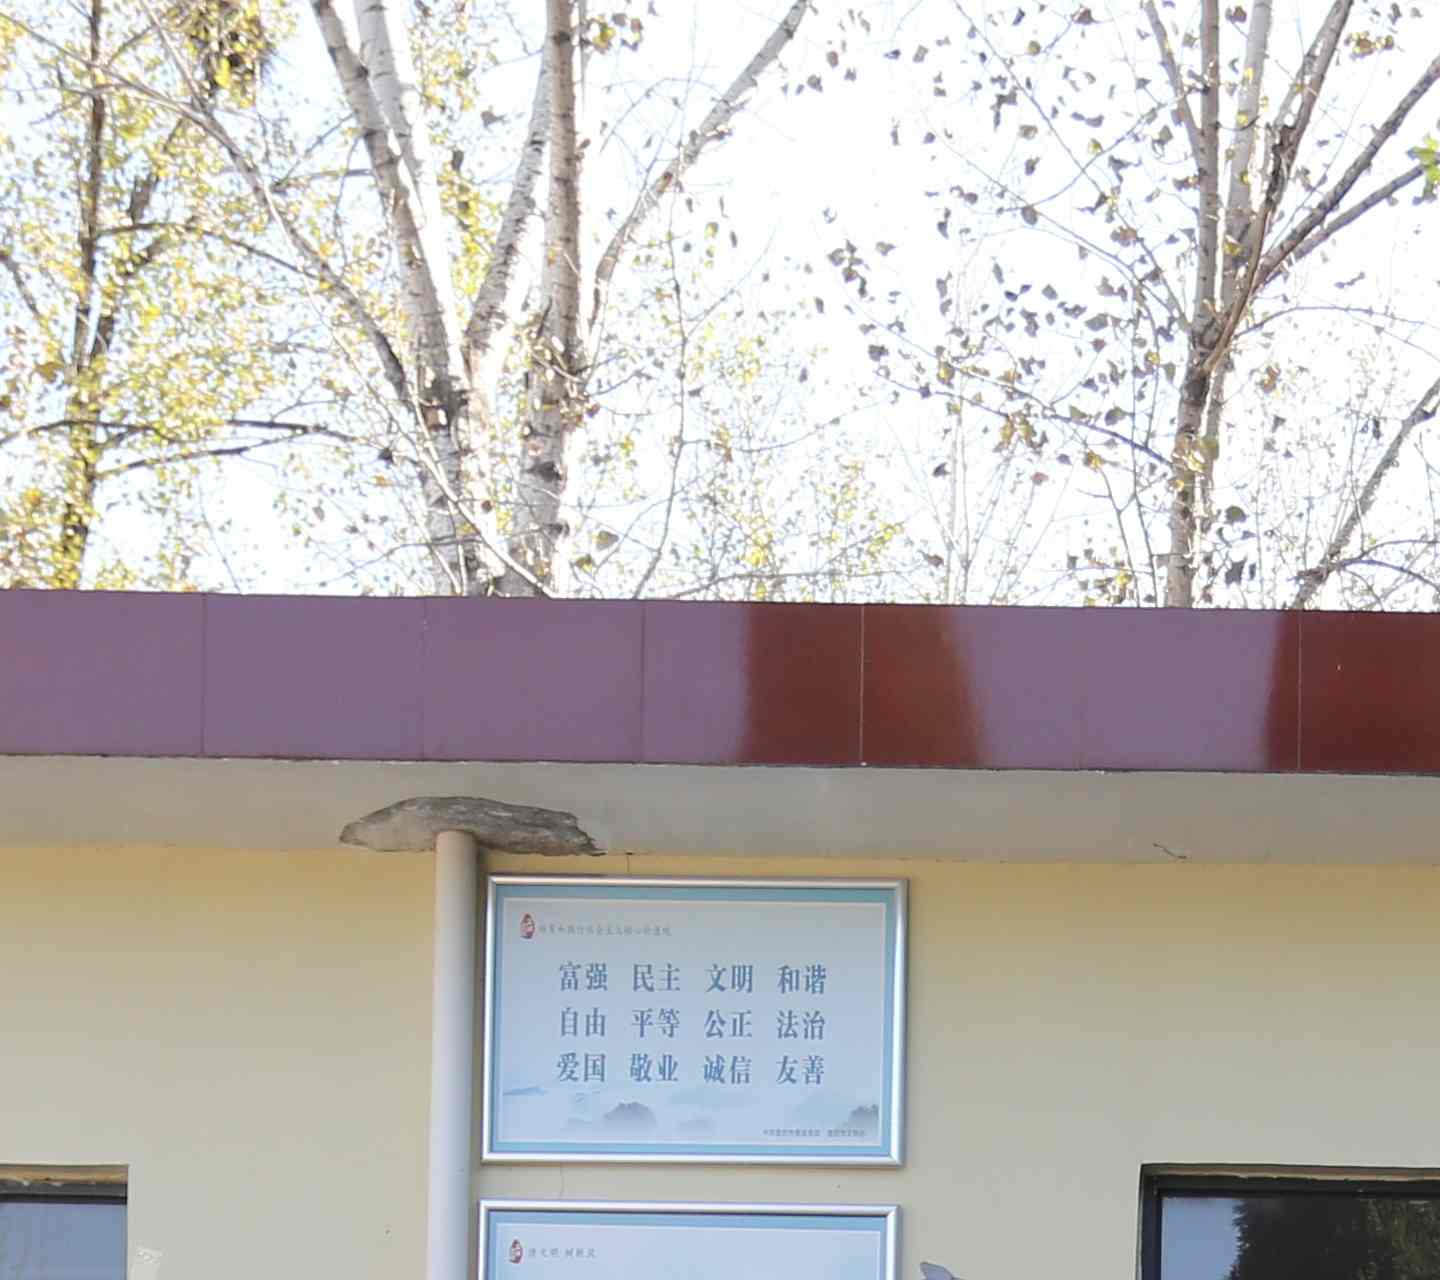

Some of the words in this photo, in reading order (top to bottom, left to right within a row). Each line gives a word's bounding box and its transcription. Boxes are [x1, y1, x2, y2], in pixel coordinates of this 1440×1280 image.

[560, 962, 608, 993] 富强
[632, 964, 680, 993] 民主
[705, 964, 753, 994] 文明
[777, 964, 826, 994] 和谐
[560, 1007, 605, 1037] 自由
[631, 1008, 680, 1039] 平等
[704, 1009, 753, 1039] 公正
[776, 1010, 825, 1041] 法治
[556, 1052, 605, 1083] 爱国
[629, 1053, 678, 1083] 敬业
[704, 1054, 752, 1084] 诚信
[776, 1055, 824, 1084] 友善
